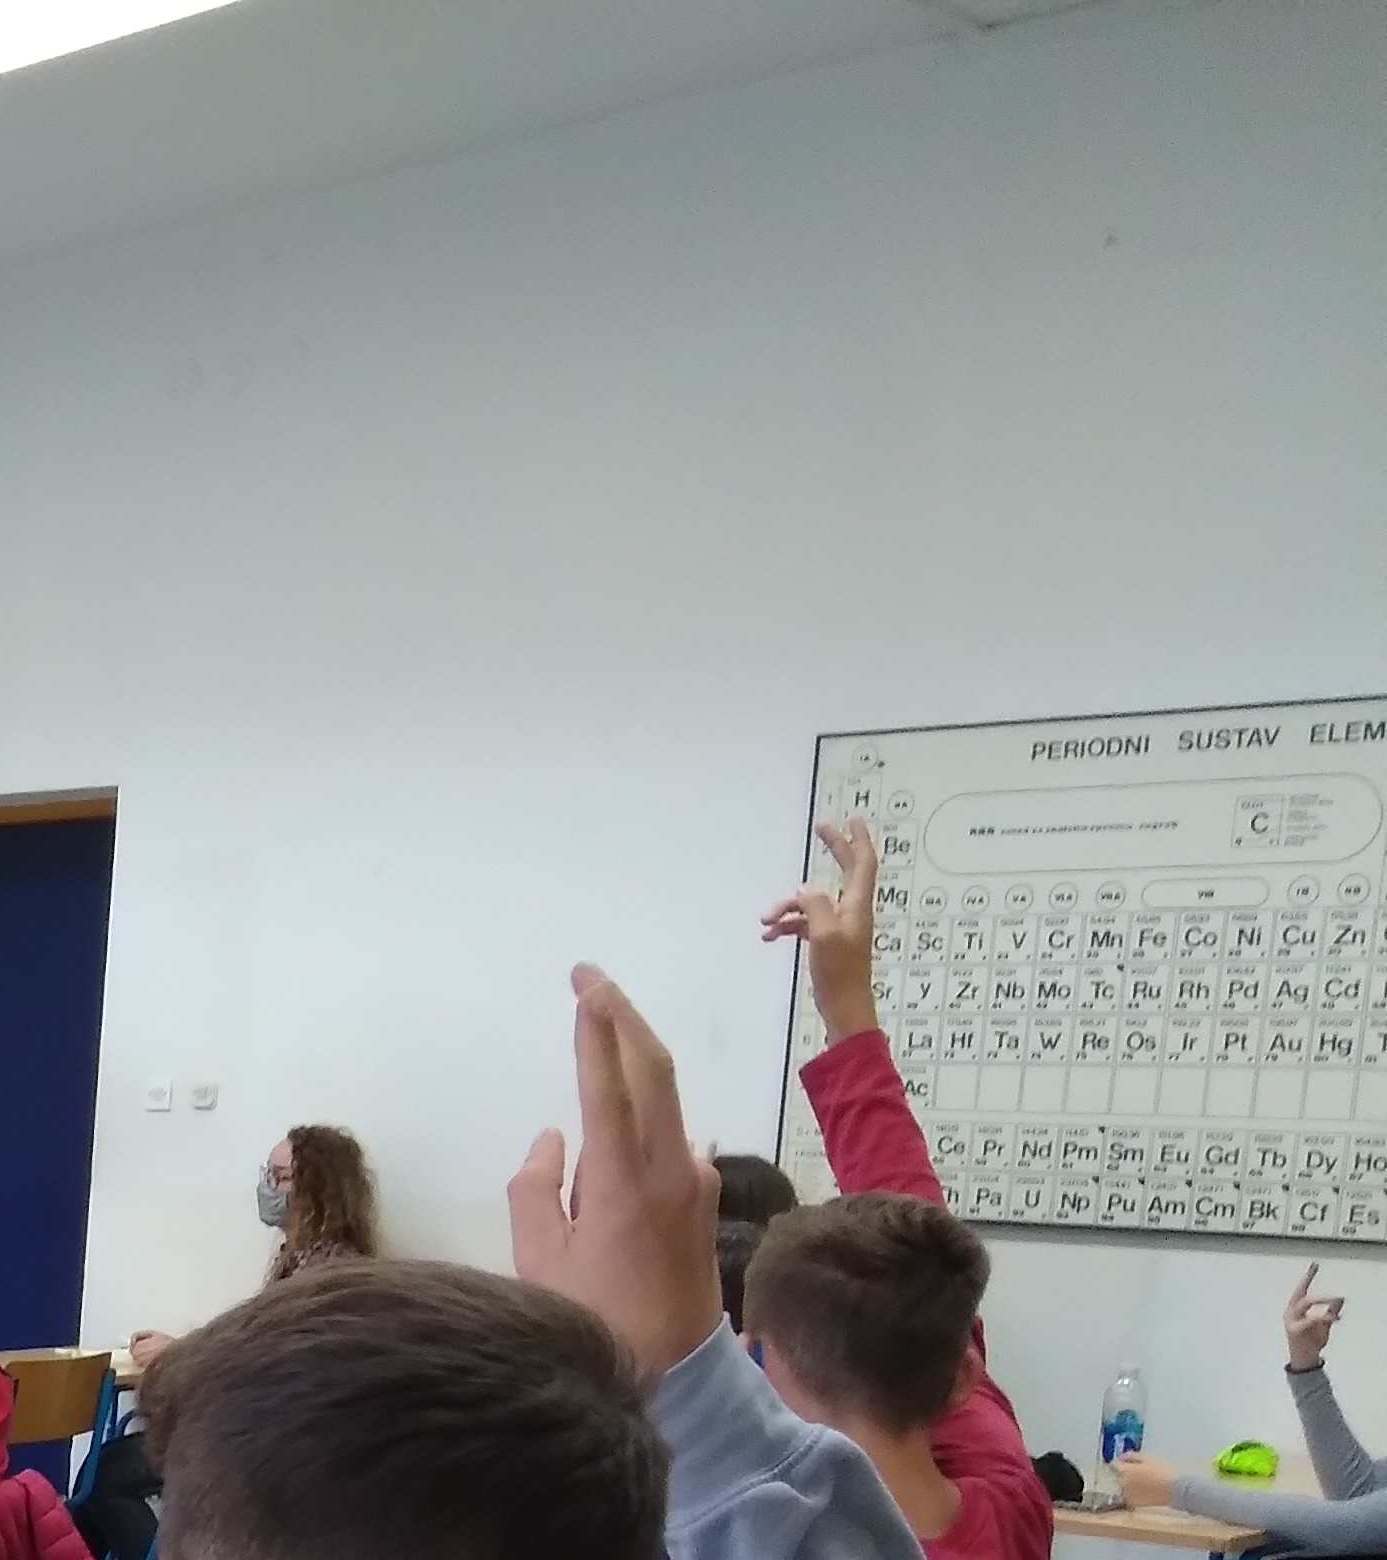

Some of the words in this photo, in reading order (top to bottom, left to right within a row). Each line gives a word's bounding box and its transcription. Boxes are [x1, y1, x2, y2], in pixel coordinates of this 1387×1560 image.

[1031, 734, 1151, 761] PERIODNI
[1178, 726, 1281, 751] SUSTAV
[1308, 720, 1387, 744] ELEM
[855, 789, 871, 808] H
[1250, 812, 1269, 835] C
[883, 836, 911, 856] Be
[877, 885, 909, 907] Mg
[874, 932, 902, 952] Ca
[917, 931, 944, 951] Sc
[1011, 930, 1028, 950] V
[1048, 929, 1075, 950] Cr
[1089, 930, 1124, 949] Mn
[1138, 927, 1167, 948] Fe
[1184, 925, 1218, 947] Co
[1282, 924, 1317, 946] Cu
[1333, 923, 1366, 946] Zn
[956, 980, 980, 1000] Zr
[994, 981, 1025, 1000] Nb
[1037, 980, 1072, 1000] Mo
[1089, 980, 1115, 1000] Tc
[1132, 980, 1162, 1000] Ru
[1178, 979, 1210, 1000] Rh
[1228, 979, 1260, 1000] Pd
[1276, 979, 1309, 1004] Ag
[1323, 976, 1362, 1000] Cd
[907, 1031, 934, 1050] La
[993, 1030, 1020, 1050] Ta
[1039, 1031, 1063, 1051] W
[1081, 1031, 1111, 1051] Re
[1269, 1032, 1304, 1052] Au
[1318, 1031, 1354, 1057] Hg
[937, 1135, 966, 1155] Ce
[982, 1138, 1007, 1157] Pr
[1021, 1140, 1053, 1160] Nd
[1062, 1141, 1099, 1161] Pm
[1108, 1140, 1145, 1161] Sm
[1159, 1144, 1190, 1165] Eu
[1204, 1144, 1241, 1166] Gd
[1256, 1146, 1288, 1169] Tb
[1305, 1150, 1339, 1175] Dy
[975, 1186, 1003, 1207] Pa
[1024, 1189, 1041, 1208] U
[1060, 1191, 1091, 1214] Np
[1106, 1192, 1136, 1214] Pu
[1147, 1195, 1187, 1216] Am
[1195, 1196, 1236, 1219] Cm
[1248, 1199, 1281, 1220] Bk
